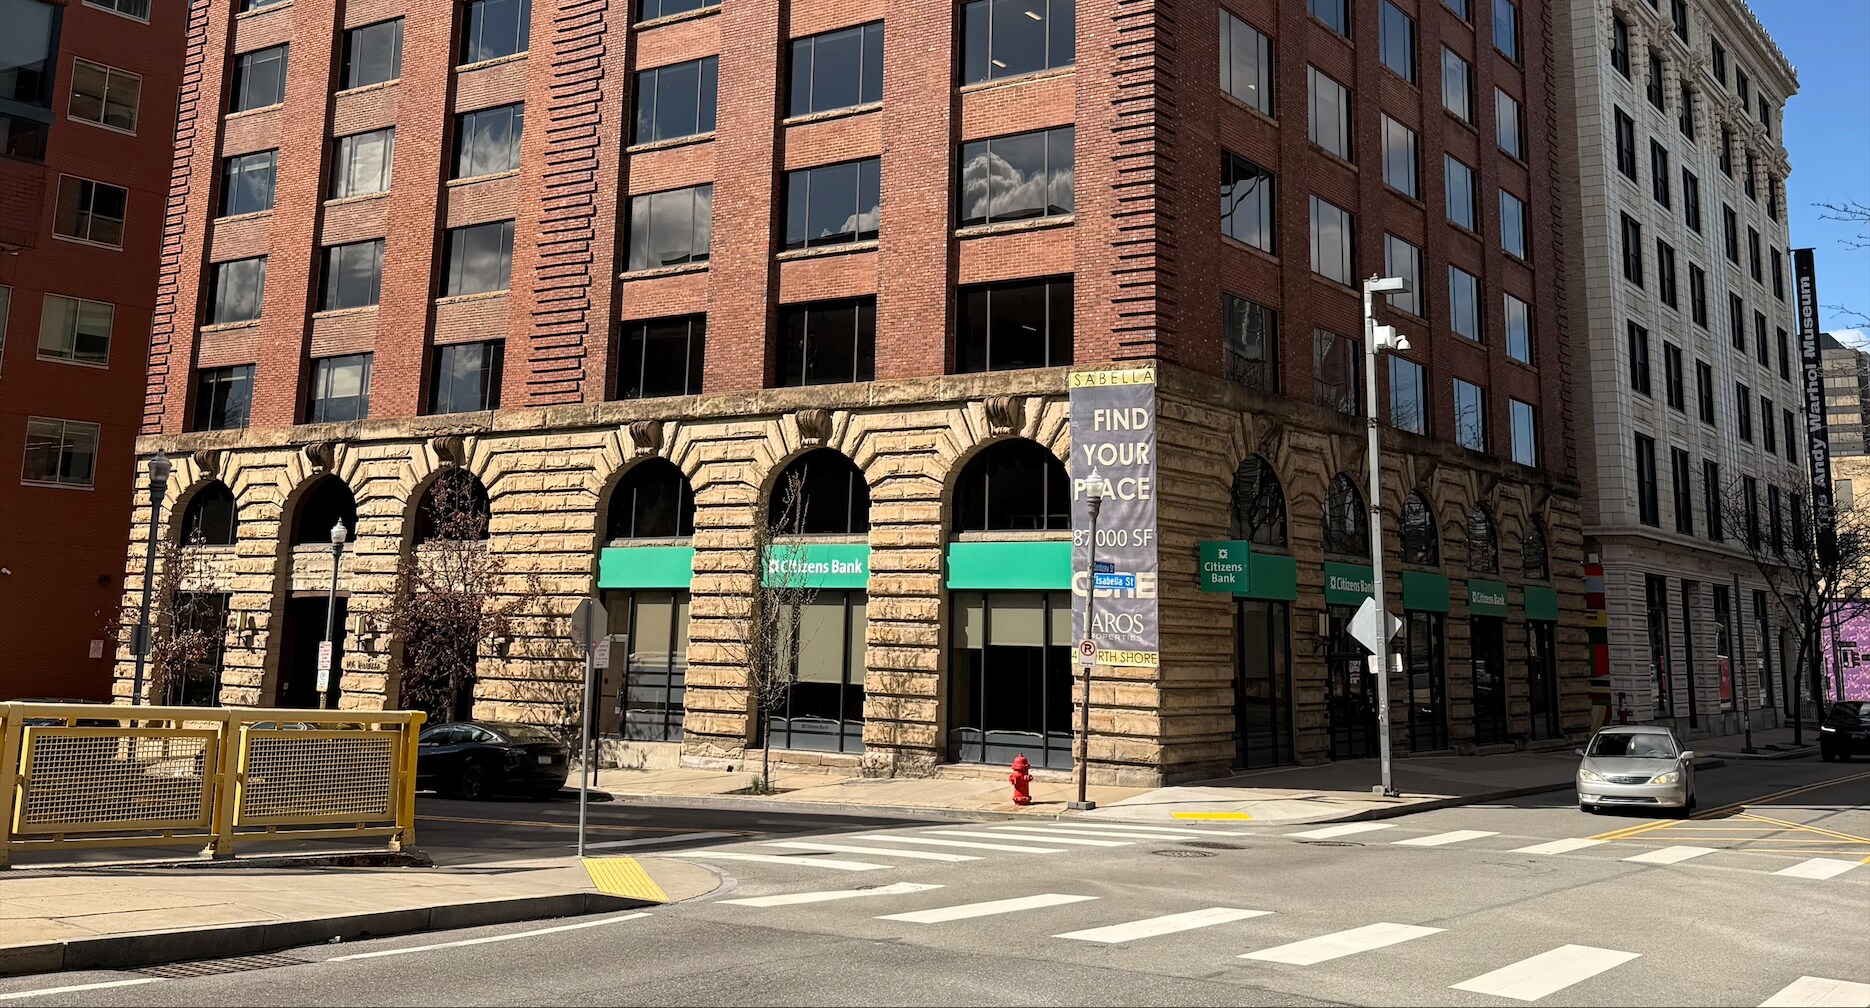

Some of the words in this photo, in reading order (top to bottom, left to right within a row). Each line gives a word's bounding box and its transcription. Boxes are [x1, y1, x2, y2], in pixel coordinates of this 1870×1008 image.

[1800, 276, 1816, 358] Museum
[1805, 363, 1823, 433] Warhol
[1094, 407, 1149, 432] FIND
[1083, 443, 1150, 467] YOUR
[1811, 438, 1826, 488] Andy
[1074, 477, 1150, 501] PACE
[1073, 529, 1128, 547] 87000
[1132, 529, 1154, 547] SF
[780, 558, 829, 573] Citizens
[831, 558, 863, 573] Bank
[1204, 561, 1243, 572] Citizens
[1071, 571, 1157, 599] CE
[1095, 575, 1123, 586] Isabella
[1125, 576, 1134, 587] St
[1211, 573, 1236, 583] Bank
[1336, 576, 1360, 592] Citizens
[1083, 632, 1143, 642] ROPERTIES
[1098, 650, 1117, 663] RTH
[1120, 651, 1157, 665] SHORE
